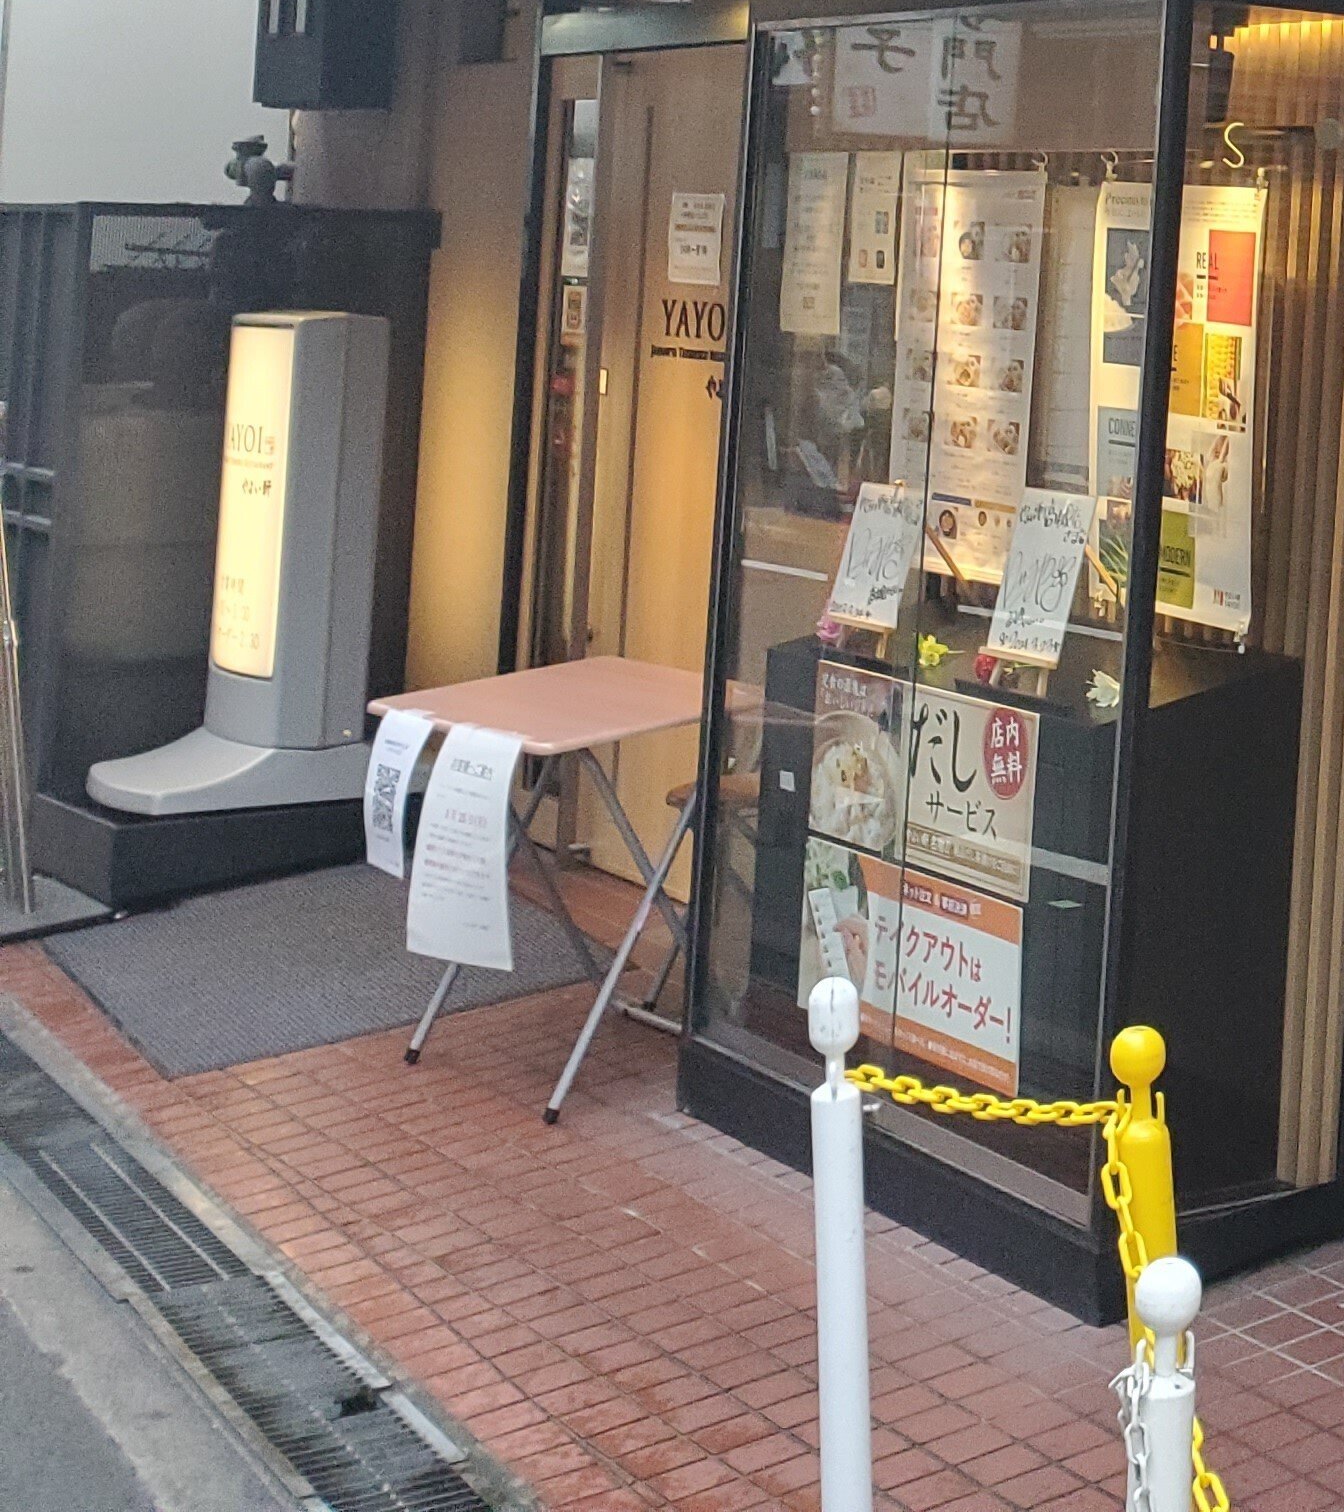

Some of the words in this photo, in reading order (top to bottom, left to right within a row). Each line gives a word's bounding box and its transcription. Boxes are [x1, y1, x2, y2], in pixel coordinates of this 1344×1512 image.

[1196, 251, 1220, 271] REAL
[661, 298, 726, 342] YAYO
[1108, 415, 1137, 437] CONNE
[990, 715, 1021, 749] 店内
[990, 749, 1024, 785] 無料
[925, 790, 998, 841] サービス
[874, 915, 982, 984] テイクアウトは
